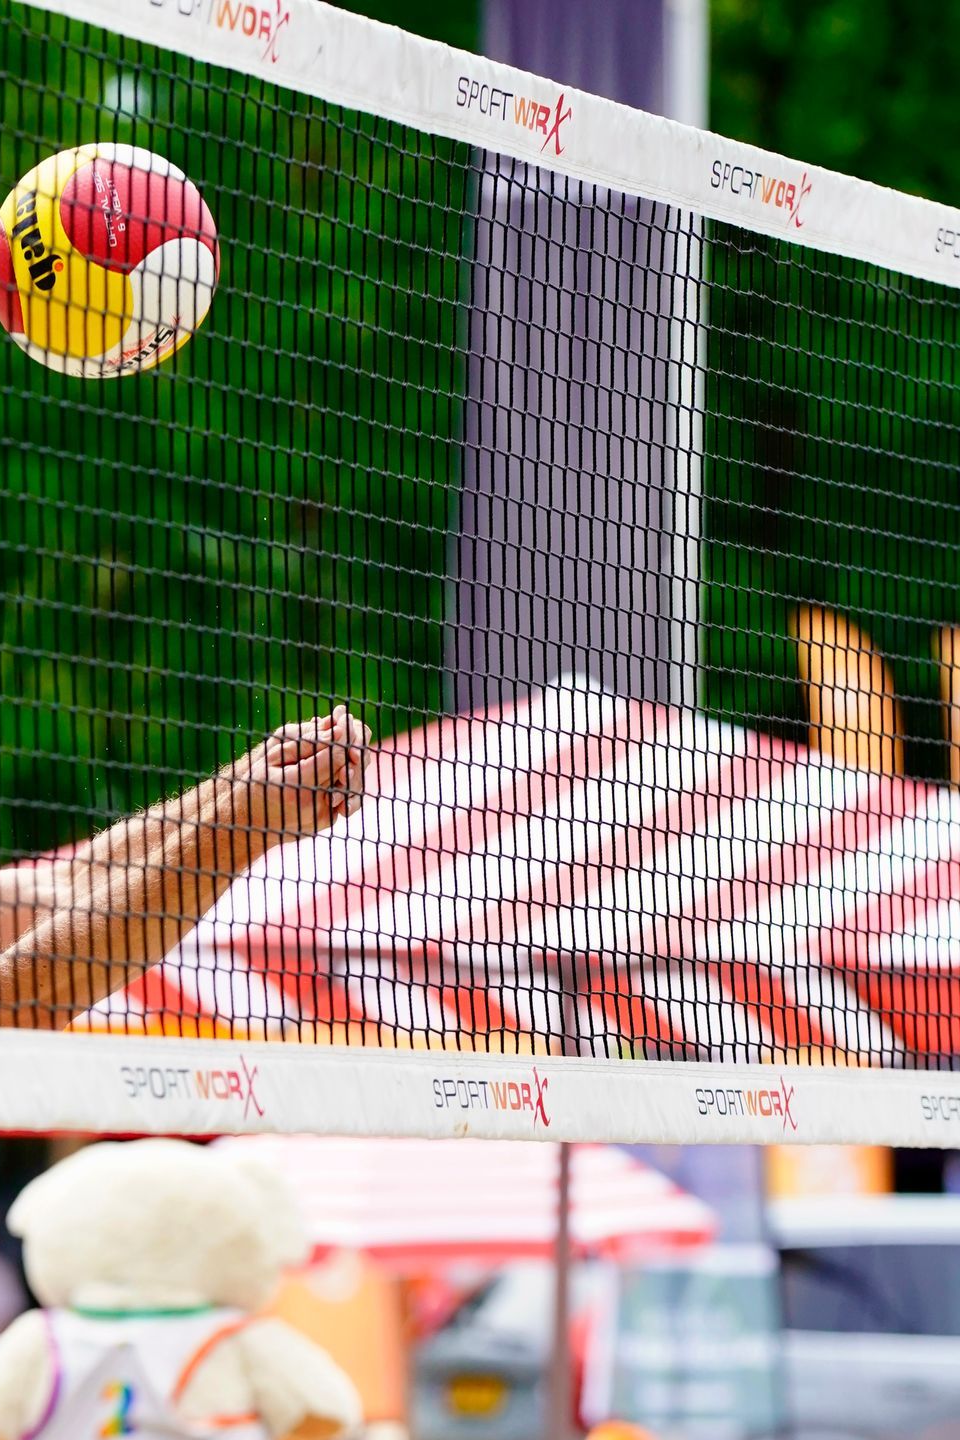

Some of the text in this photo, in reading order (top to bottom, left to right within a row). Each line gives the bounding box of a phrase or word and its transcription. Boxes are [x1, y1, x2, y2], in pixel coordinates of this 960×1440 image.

[120, 1053, 264, 1121] SPORTWORX
[433, 1066, 551, 1129] SPORTWORX
[696, 1076, 798, 1131] SPORTWORX
